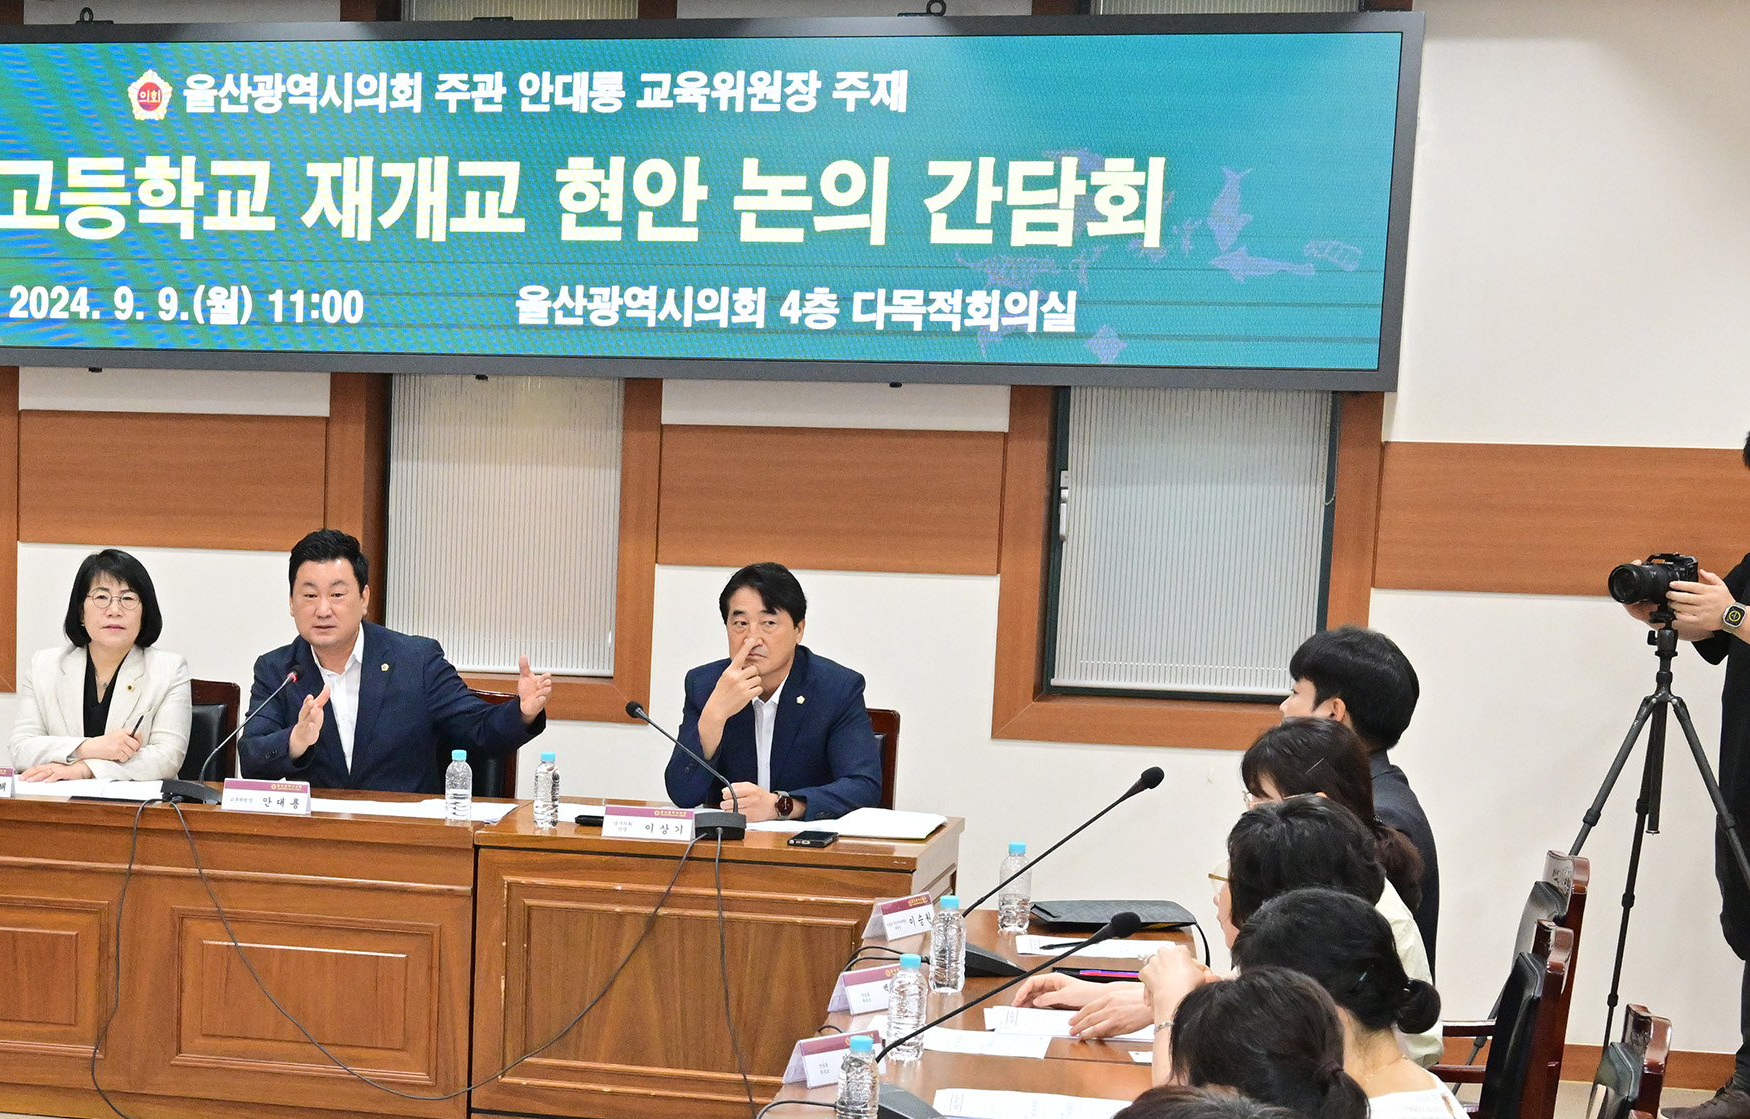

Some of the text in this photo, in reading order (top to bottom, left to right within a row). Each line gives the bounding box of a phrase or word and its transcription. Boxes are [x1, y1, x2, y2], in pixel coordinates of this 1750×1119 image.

[138, 89, 161, 104] 의회
[183, 69, 908, 114] 울산광역시의회 주관 안대룡 교육위원장 주재
[301, 155, 526, 242] 재개교
[555, 156, 709, 242] 현안
[733, 156, 890, 246] 논의
[923, 156, 1166, 248] 간담회
[8, 284, 364, 325] 2024. 9. 9.(월) 11:00
[515, 284, 1078, 333] 울산광역시의회 4층 다목적회의실
[644, 822, 684, 836] 이상기
